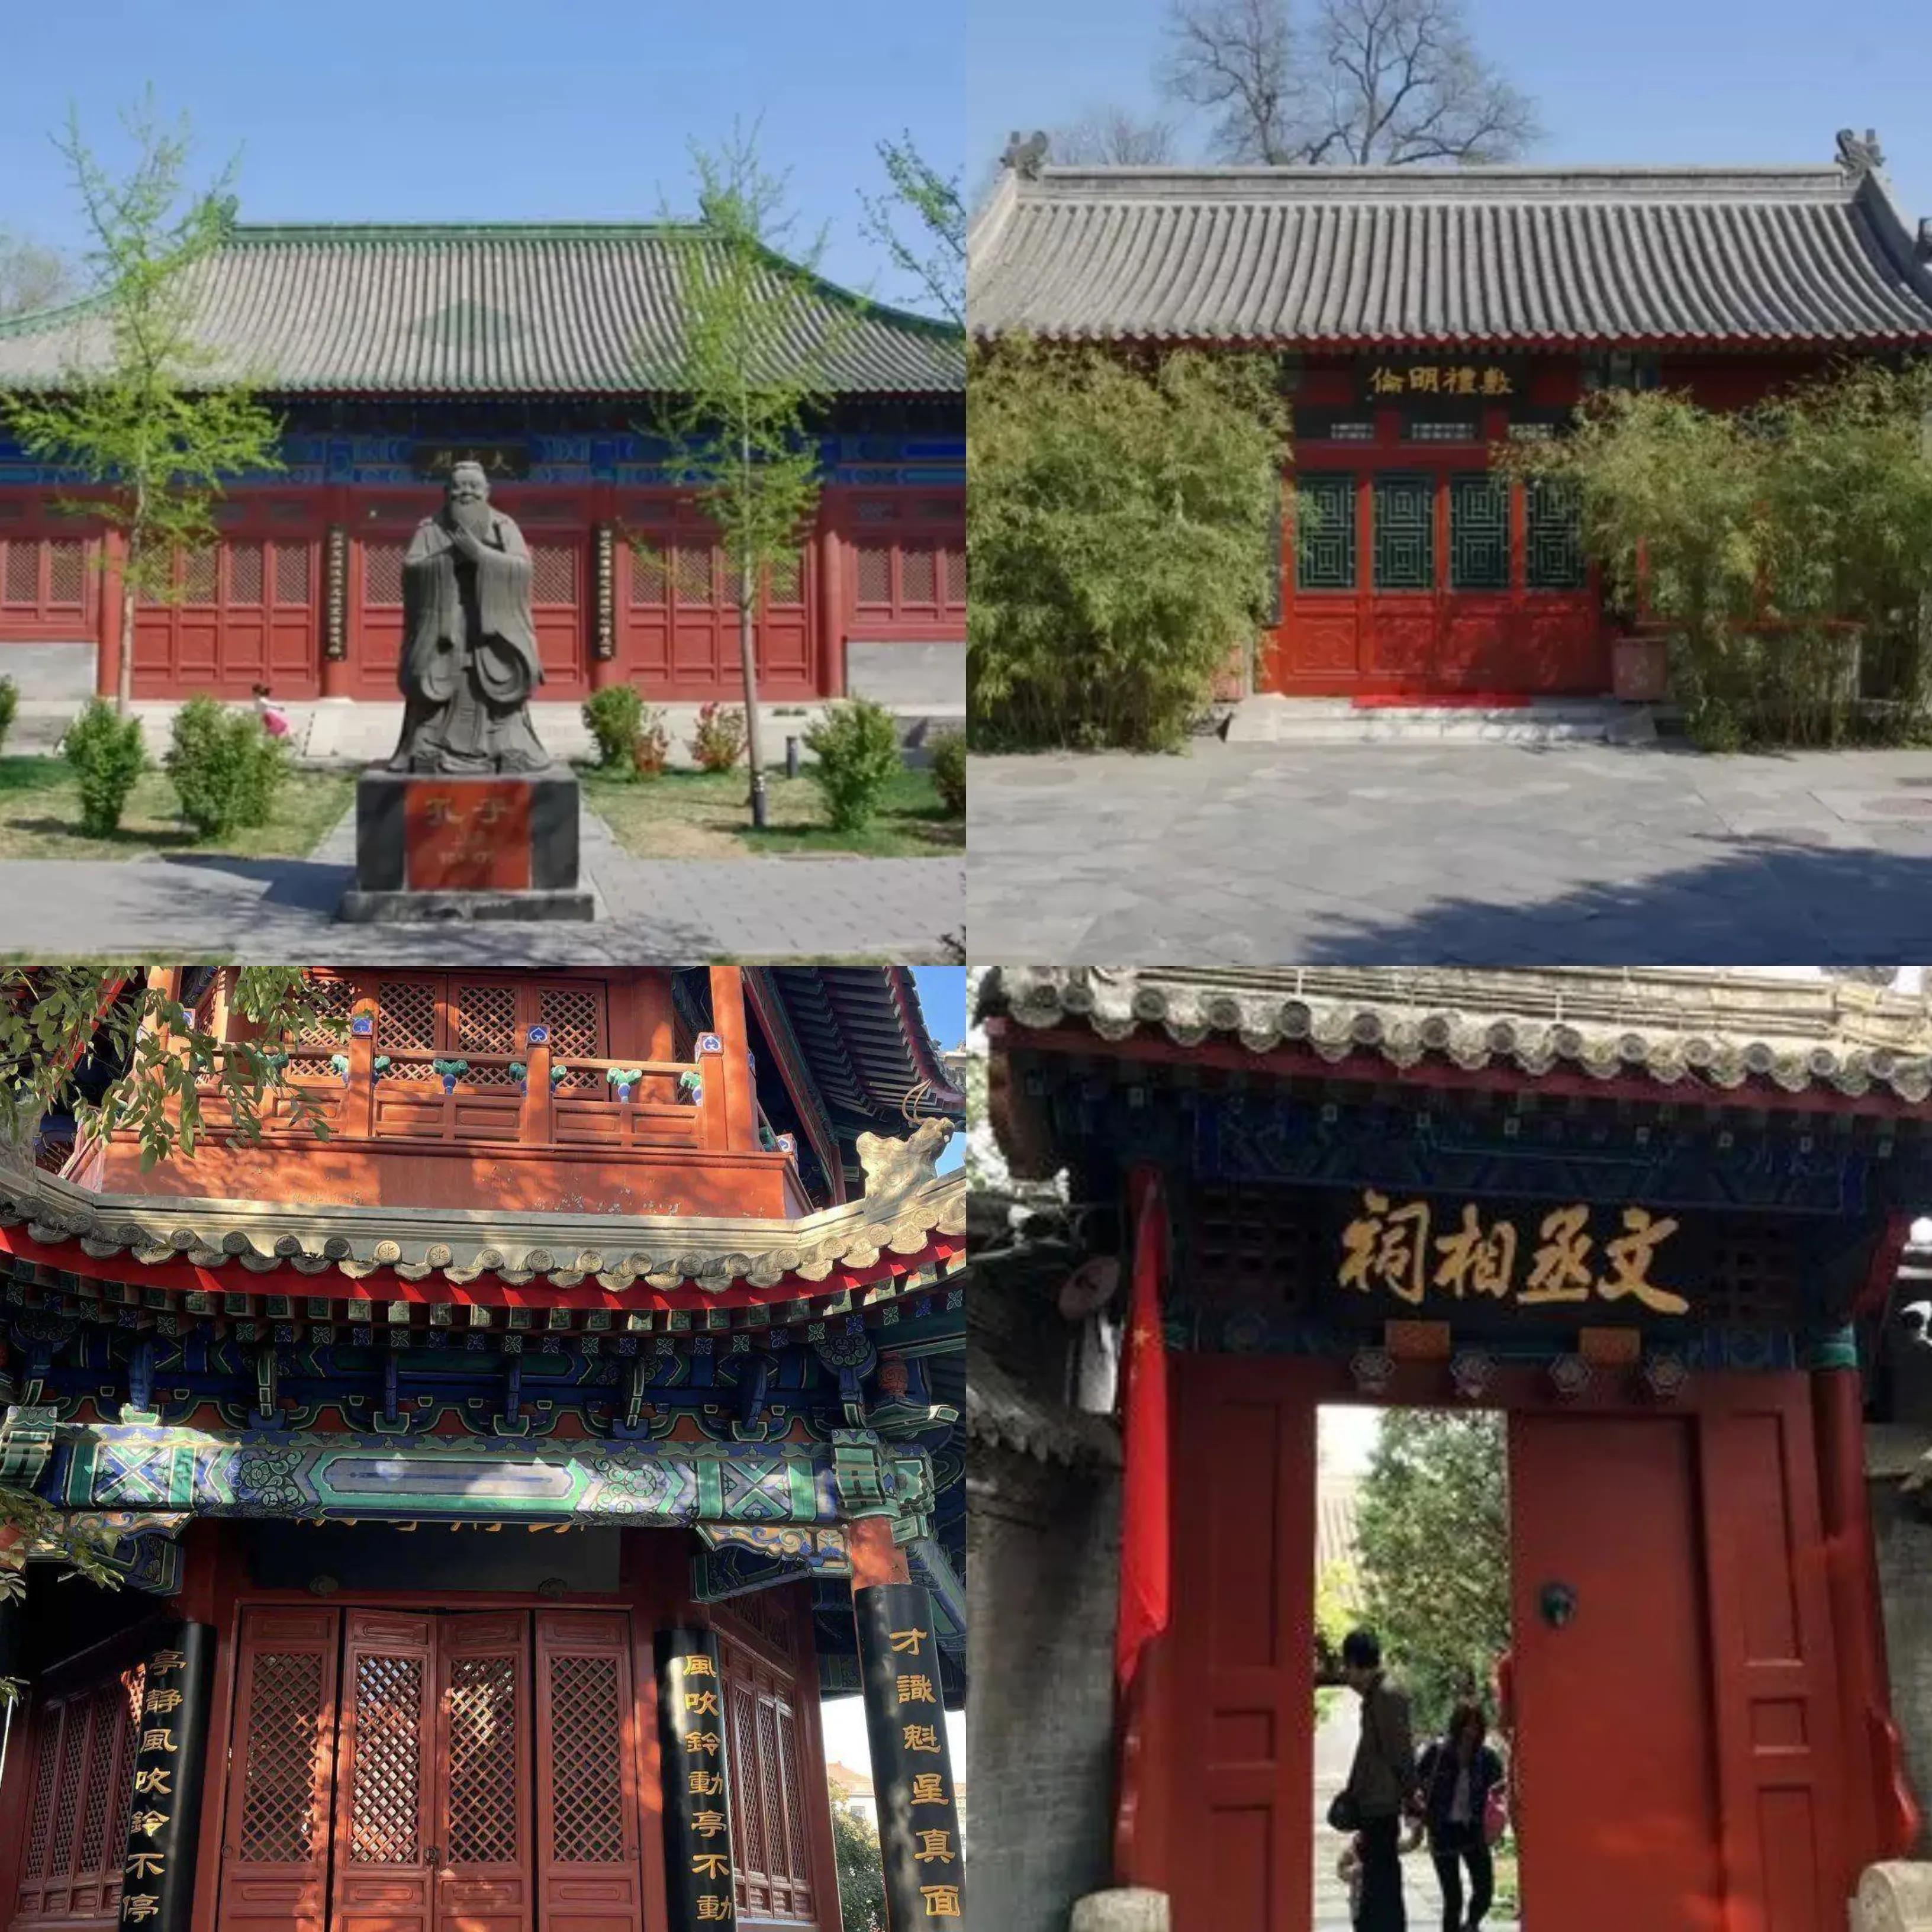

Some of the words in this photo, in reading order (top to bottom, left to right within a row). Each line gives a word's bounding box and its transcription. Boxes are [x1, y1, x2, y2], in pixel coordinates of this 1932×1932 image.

[1338, 1189, 1689, 1315] 文丞相祠
[682, 1655, 733, 1921] 風吹鈴動亭不動
[889, 1627, 961, 1917] 才識魁星真面
